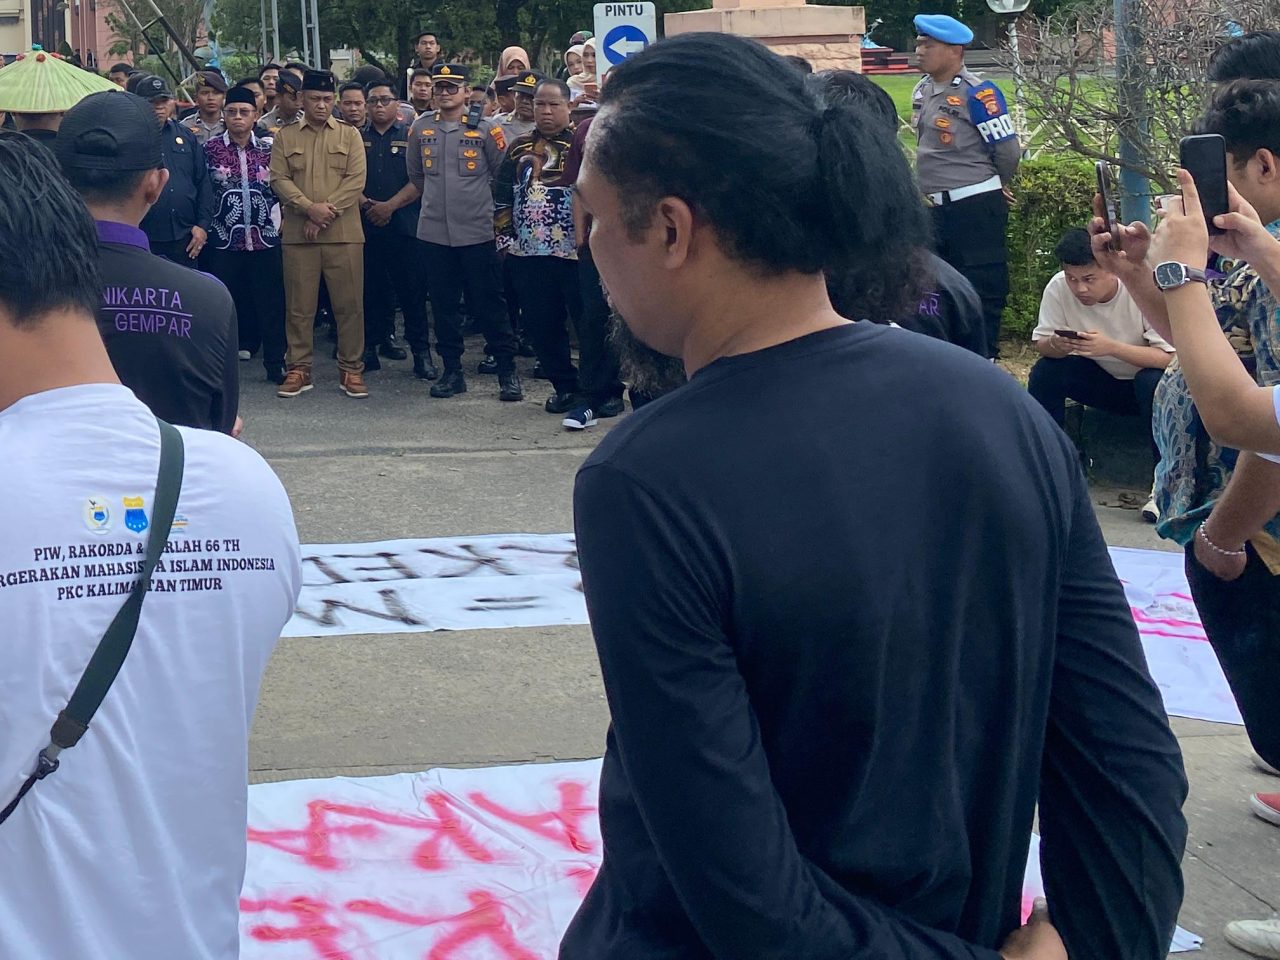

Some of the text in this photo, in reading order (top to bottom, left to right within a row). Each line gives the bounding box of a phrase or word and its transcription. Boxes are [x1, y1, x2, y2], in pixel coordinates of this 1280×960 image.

[605, 4, 643, 16] PINTU
[103, 287, 182, 310] NIKARTA
[115, 313, 191, 338] GEMPAR
[34, 548, 66, 561] PIW,
[68, 543, 133, 559] RAKORDA
[163, 540, 201, 554] RLAH
[205, 539, 220, 552] 66
[223, 538, 240, 551] TH
[84, 558, 166, 578] MAHASISA
[169, 557, 213, 573] ISLAM
[217, 556, 275, 572] INDONESIA
[57, 577, 223, 601] PKC KALIMATAN TIMUR
